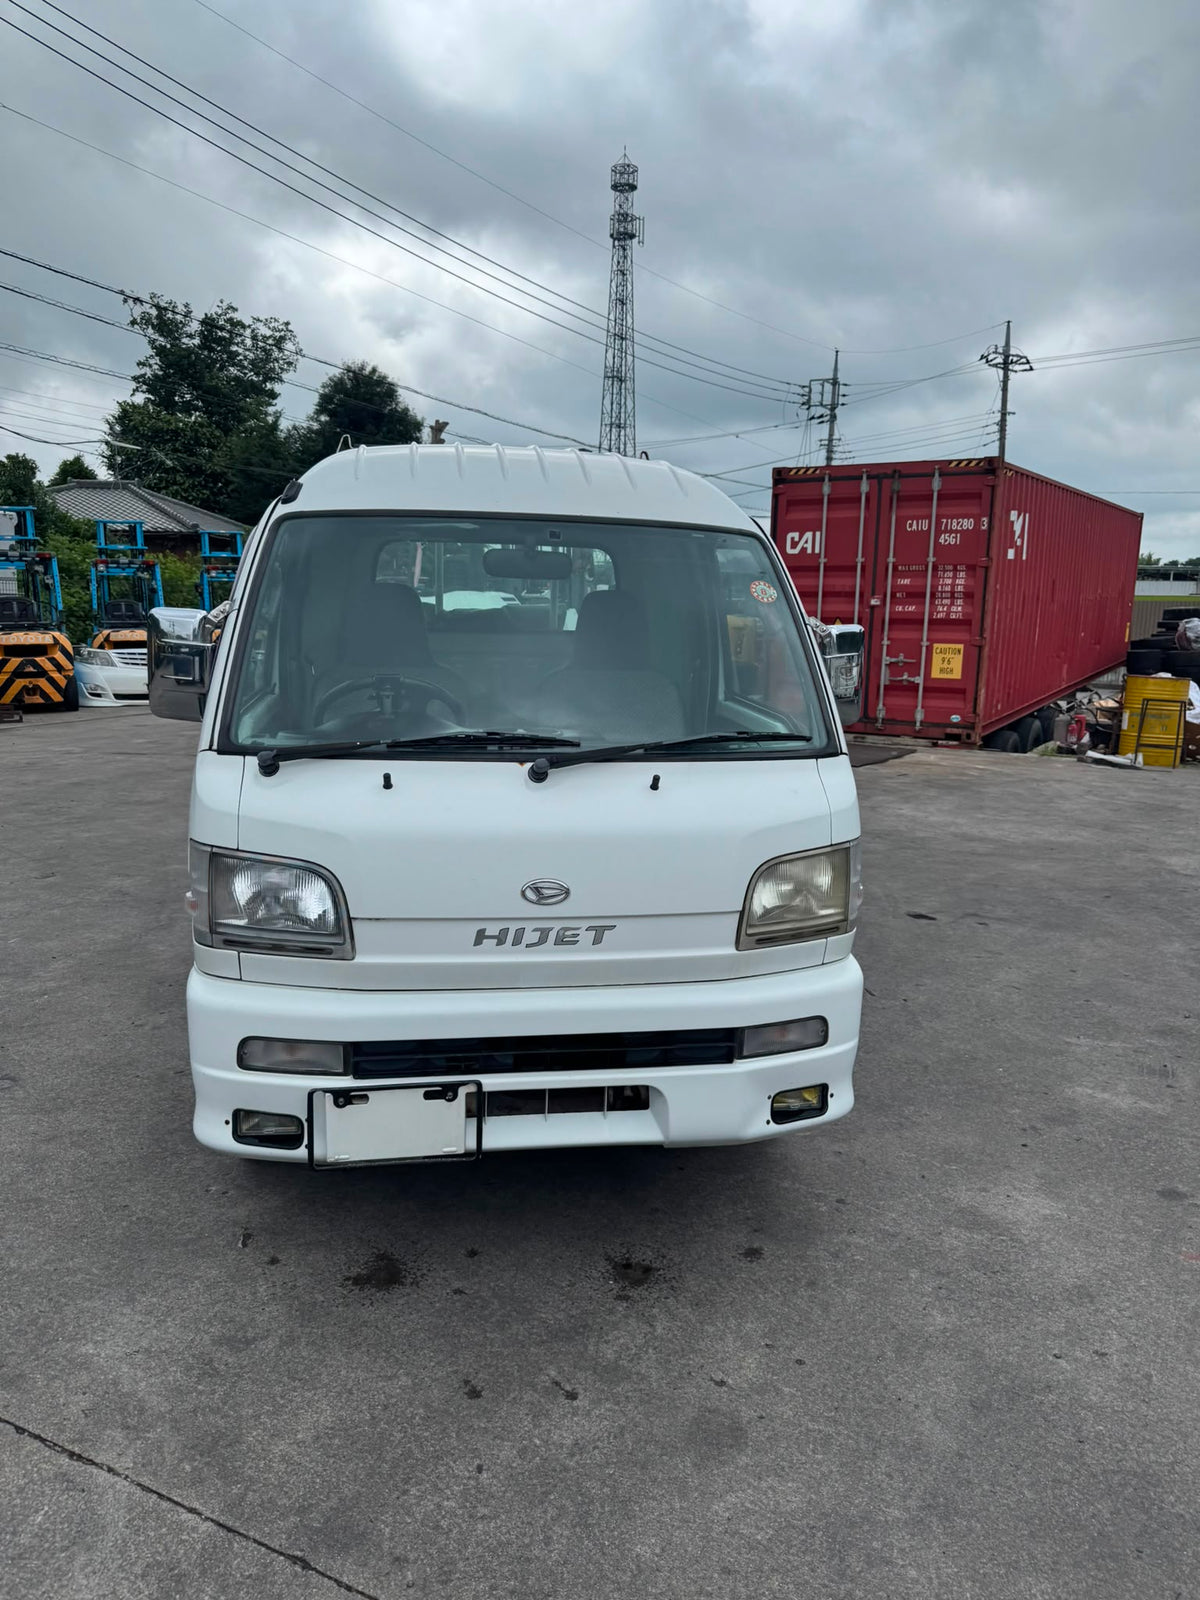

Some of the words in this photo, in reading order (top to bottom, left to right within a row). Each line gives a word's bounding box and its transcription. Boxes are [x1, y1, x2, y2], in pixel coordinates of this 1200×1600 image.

[906, 519, 928, 531] CAIU
[941, 518, 974, 530] 718280
[981, 517, 988, 530] 3
[786, 531, 821, 554] CAI
[939, 533, 960, 545] 45G1
[0, 635, 52, 643] TOYOTA
[935, 647, 962, 656] CAUTION
[473, 924, 617, 948] HIJET
